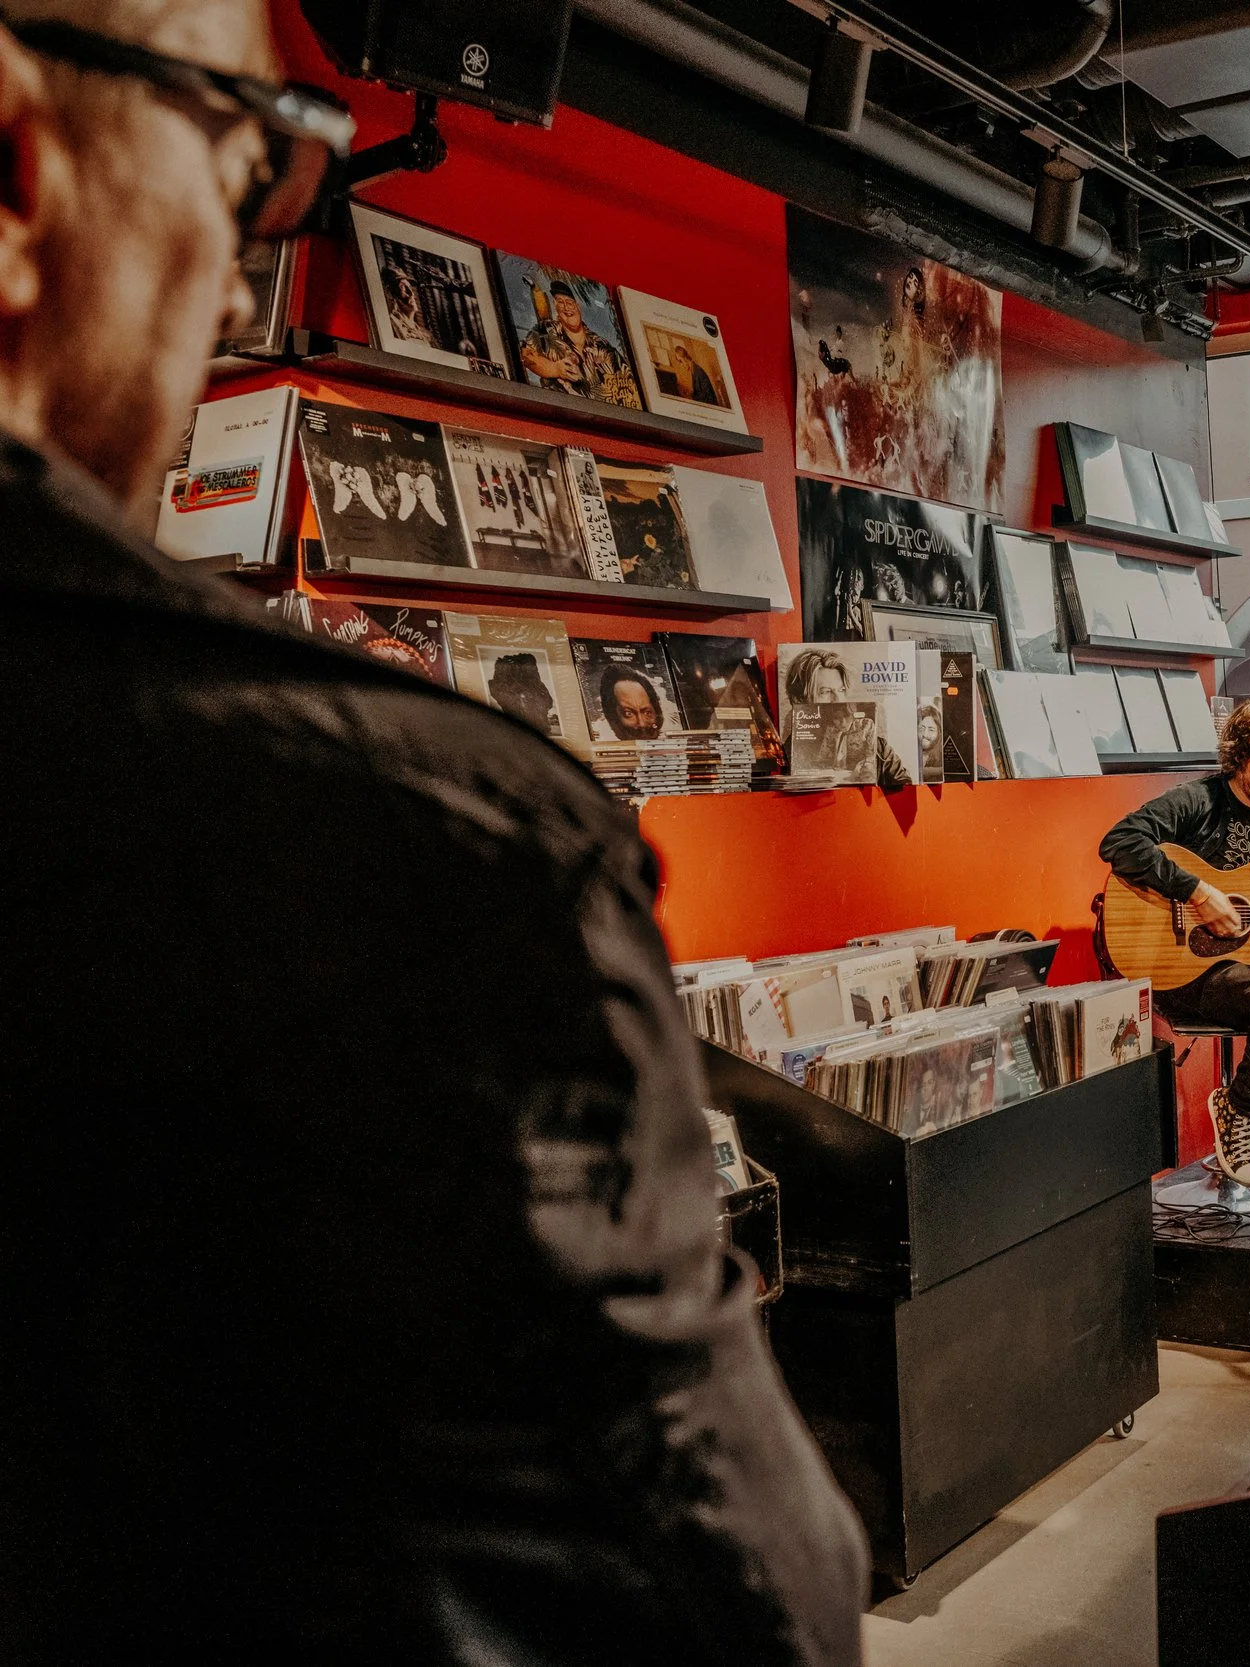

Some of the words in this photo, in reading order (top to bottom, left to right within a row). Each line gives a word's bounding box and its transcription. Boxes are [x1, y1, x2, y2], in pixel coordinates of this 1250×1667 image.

[461, 74, 484, 90] YAMAHA
[213, 465, 258, 481] STRUMMER
[205, 476, 257, 492] MESCALEROS
[584, 497, 600, 543] MORBY
[897, 549, 906, 557] LIVE
[913, 552, 930, 560] CONCERT
[595, 551, 608, 582] EVIN
[322, 609, 369, 645] SMASHING
[390, 607, 442, 662] PUMPKINS
[602, 646, 636, 655] THUNDERCAT
[863, 661, 906, 673] DAVID
[861, 673, 909, 684] BOWIE
[796, 705, 821, 720] David
[853, 963, 880, 976] JOHNNY
